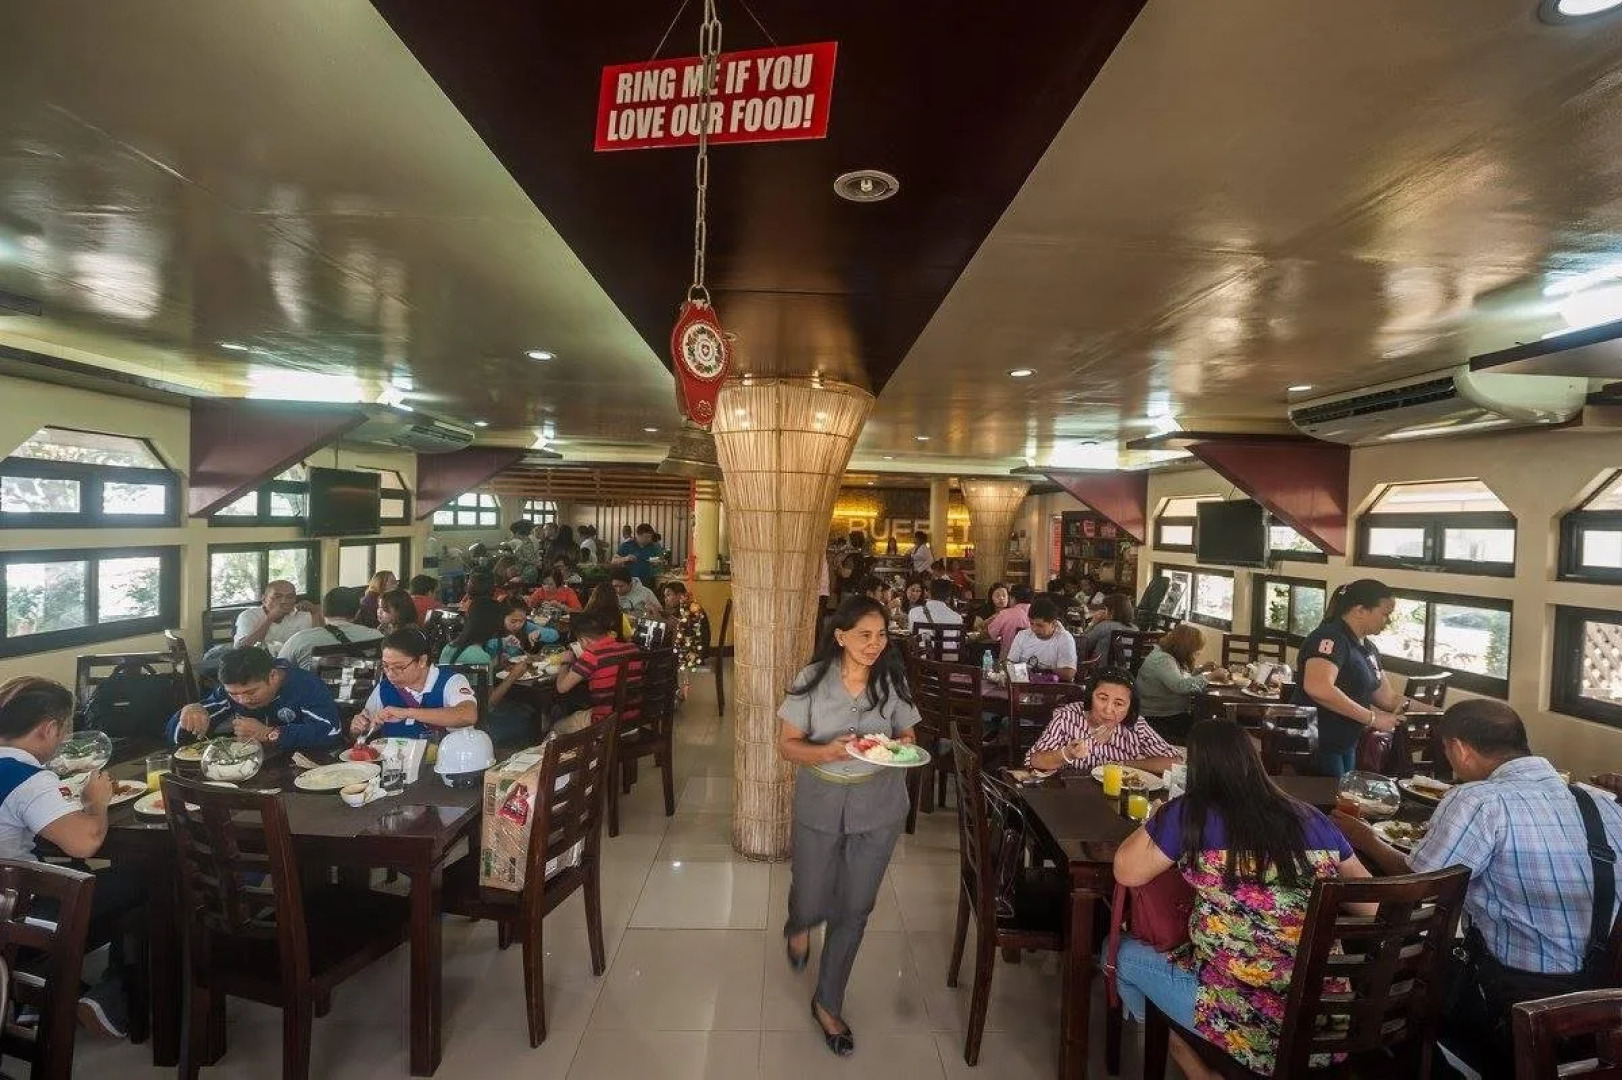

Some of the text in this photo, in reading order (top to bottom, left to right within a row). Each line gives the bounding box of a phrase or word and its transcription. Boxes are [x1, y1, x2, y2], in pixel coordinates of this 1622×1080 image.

[615, 67, 677, 104] RING
[725, 60, 751, 94] IF
[757, 53, 814, 92] YOU
[606, 93, 815, 142] LOVE OUR FOOD!
